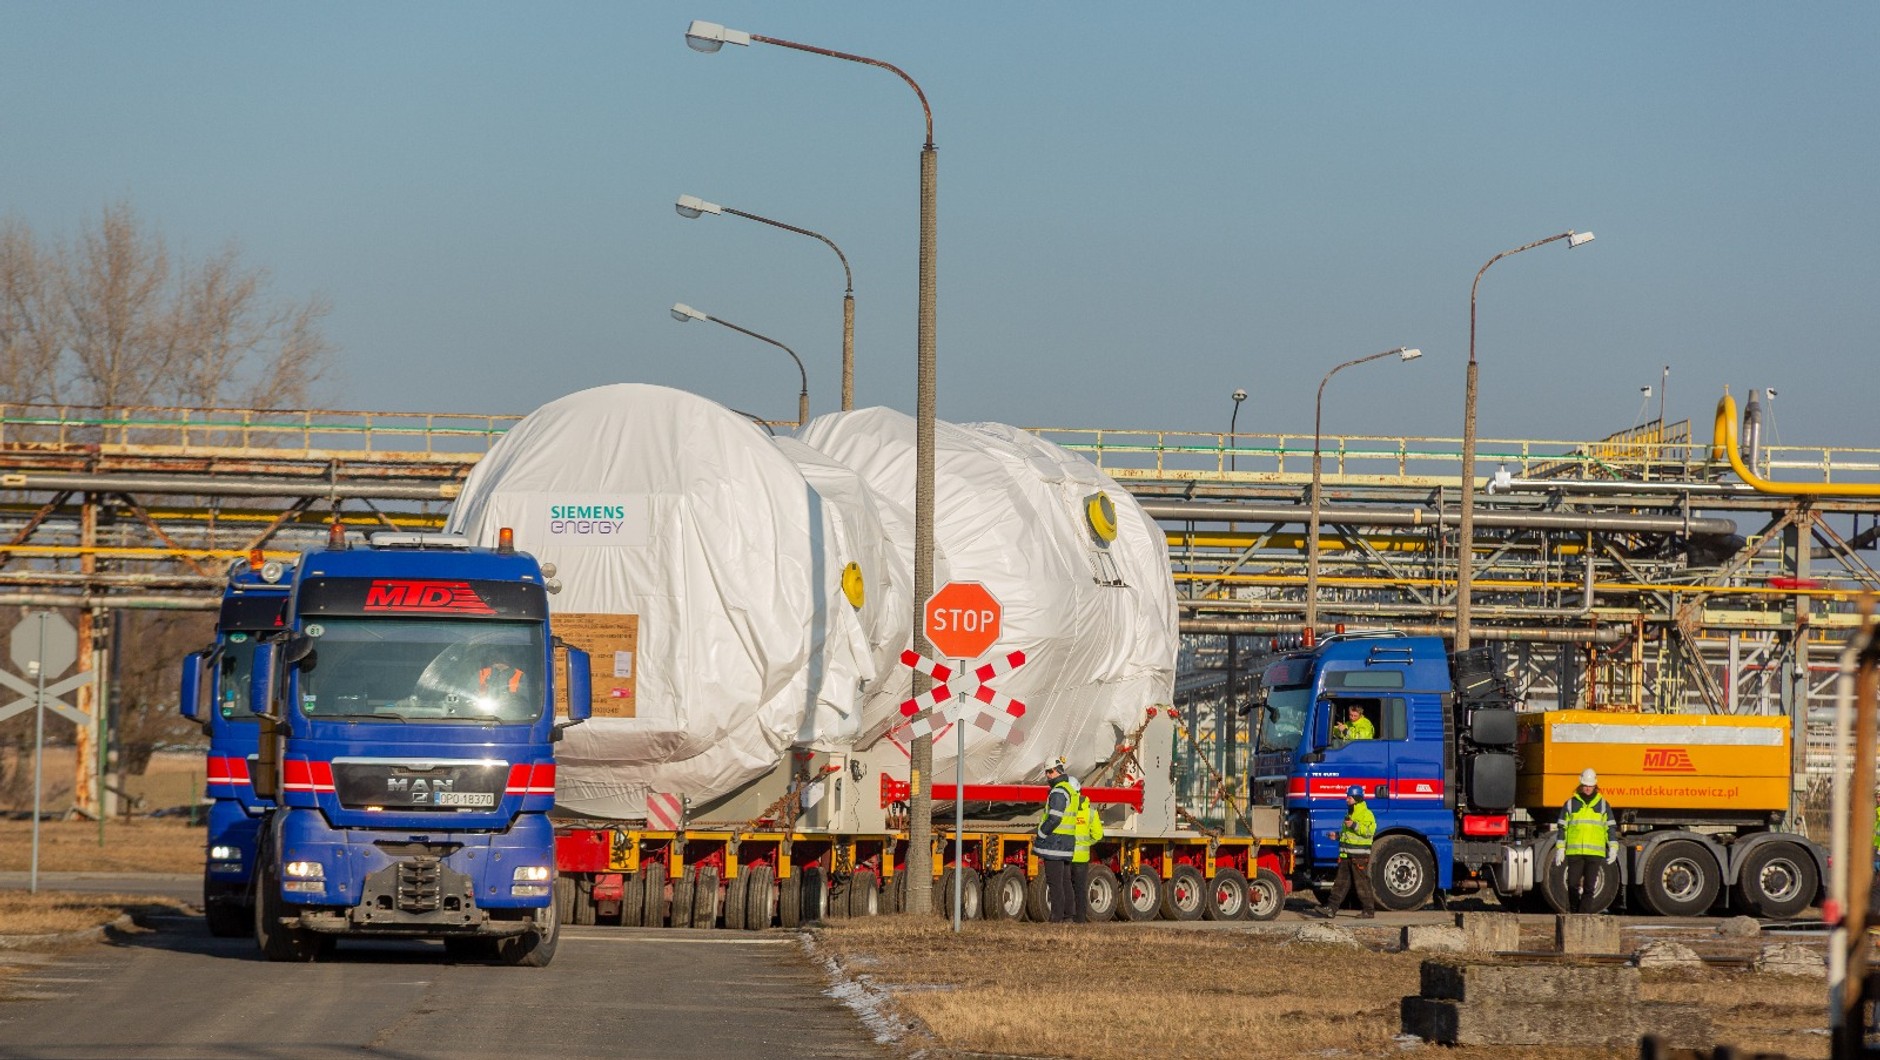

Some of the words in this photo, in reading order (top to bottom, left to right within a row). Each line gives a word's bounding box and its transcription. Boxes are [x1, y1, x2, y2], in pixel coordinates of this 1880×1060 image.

[551, 505, 624, 519] SIEMENS
[551, 520, 624, 534] energy
[933, 608, 995, 632] STOP
[387, 778, 454, 792] MAN
